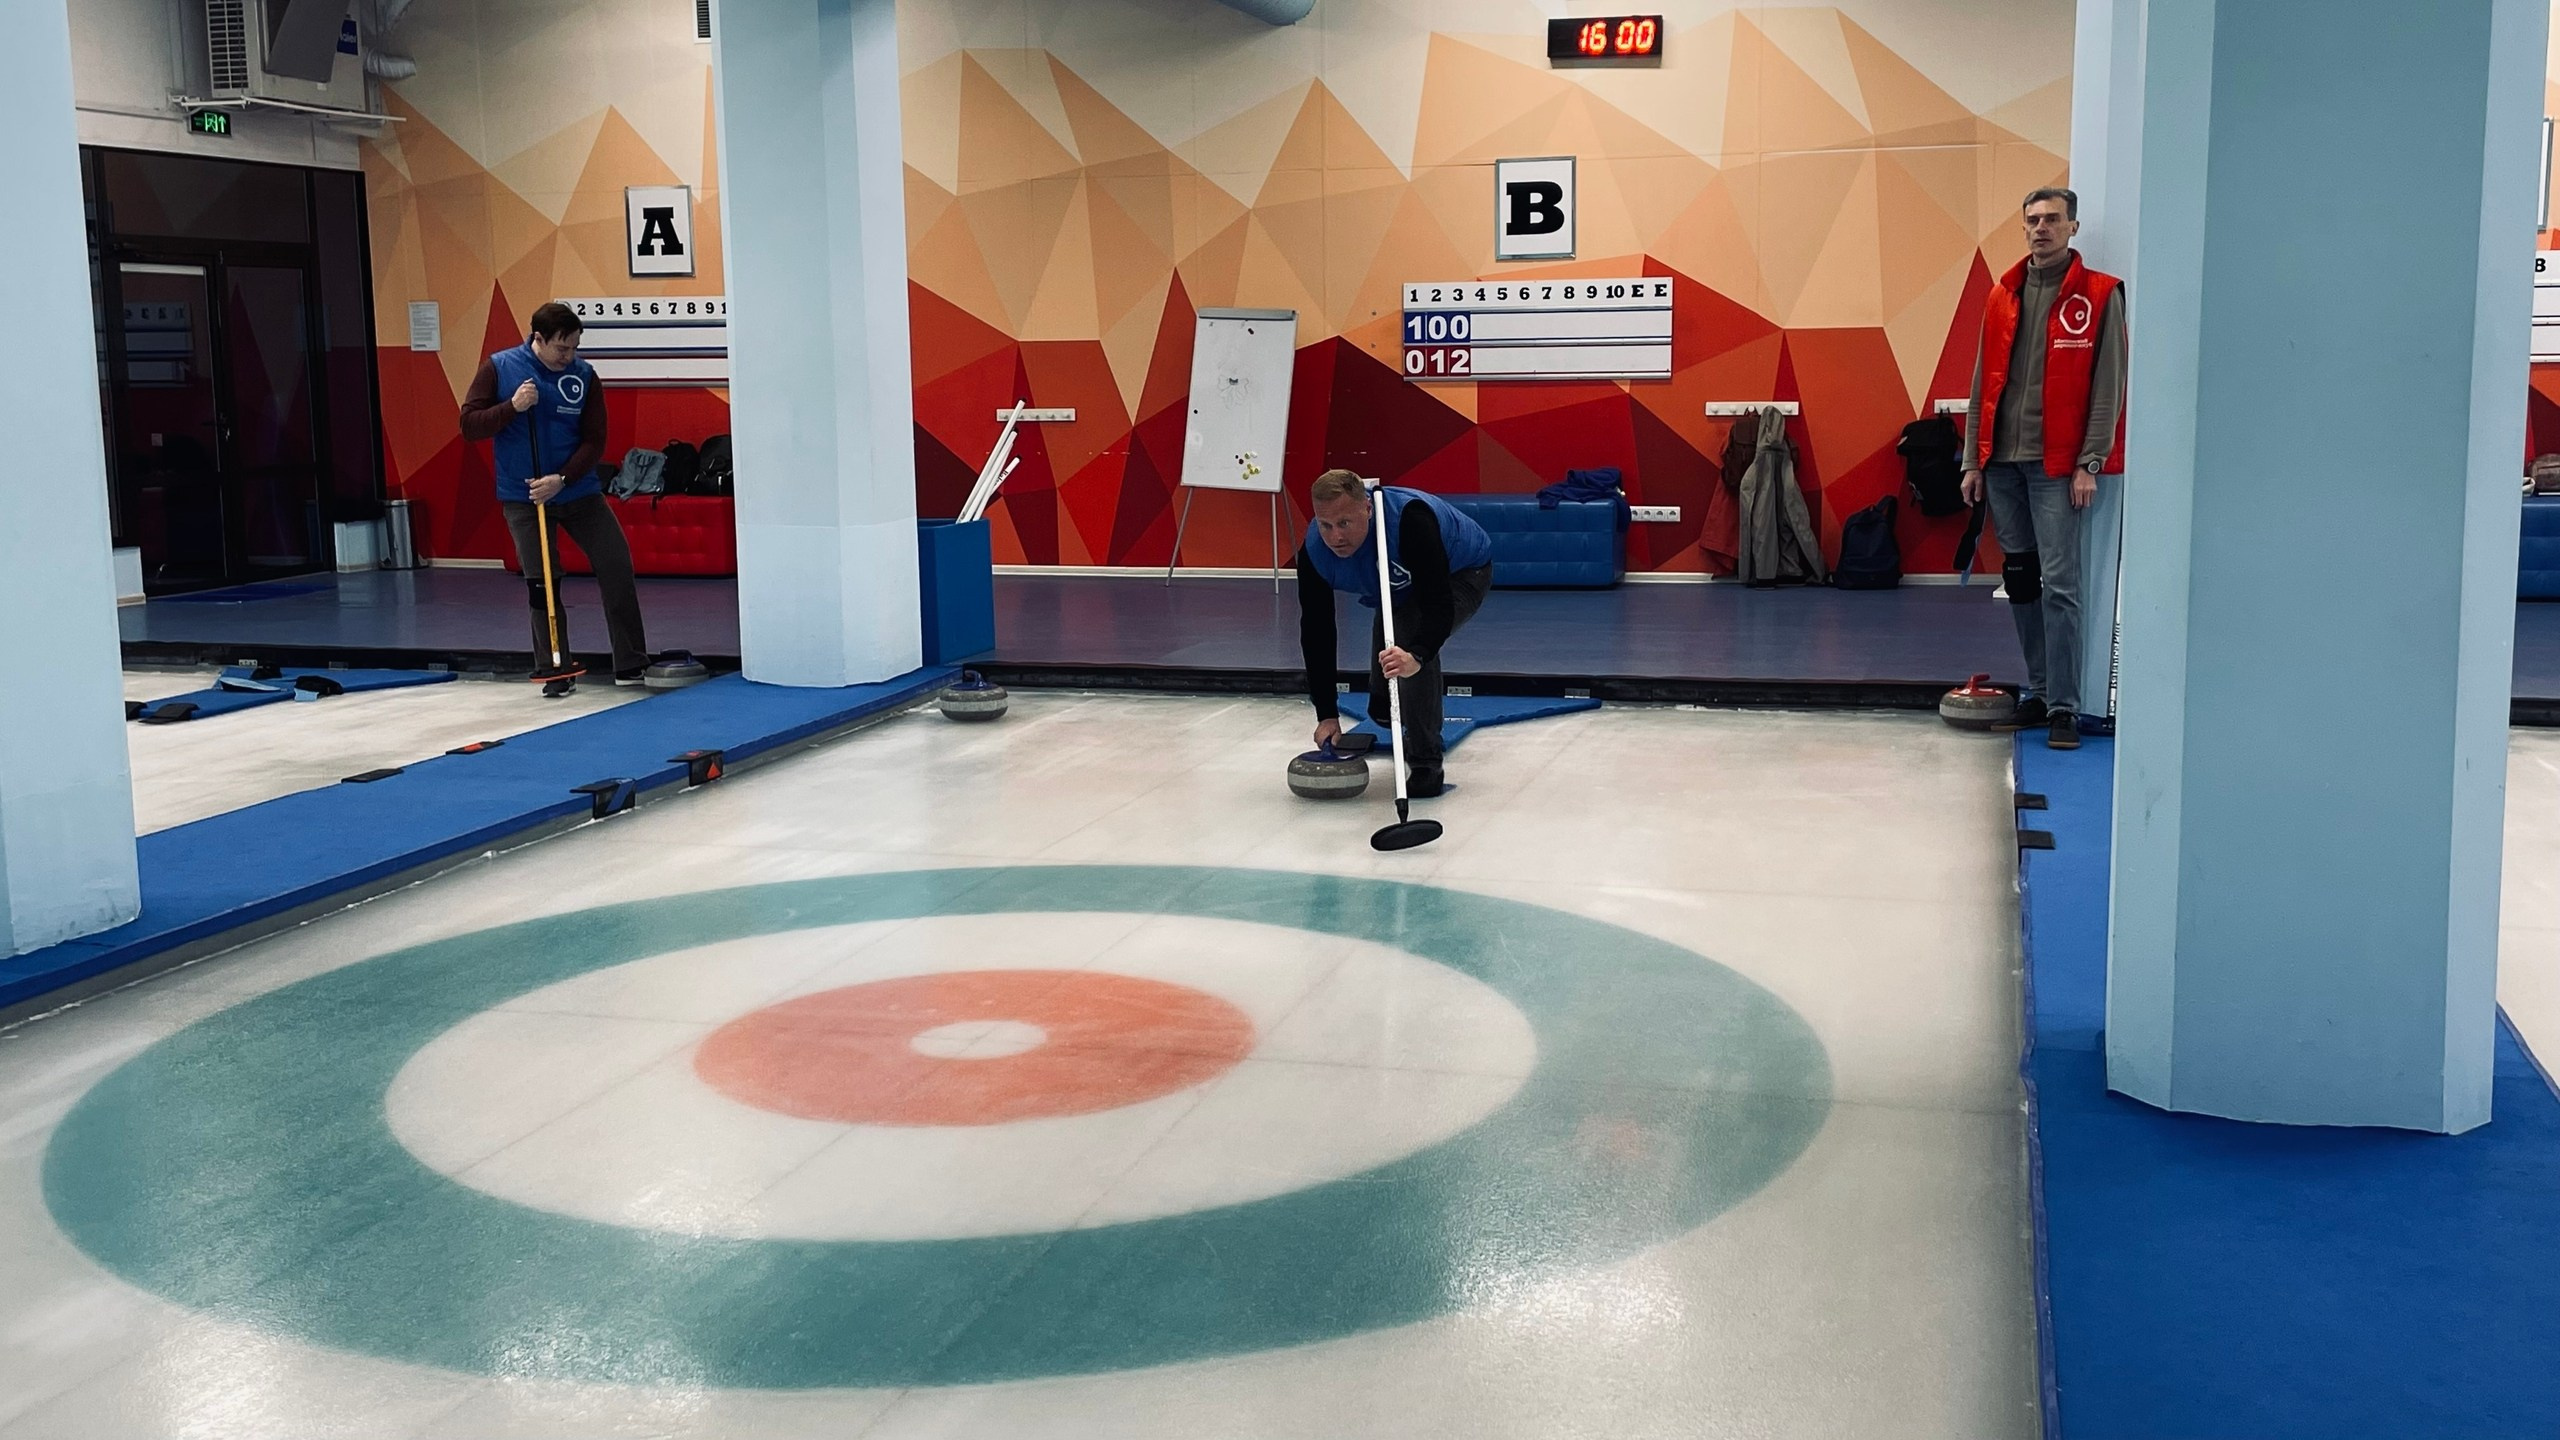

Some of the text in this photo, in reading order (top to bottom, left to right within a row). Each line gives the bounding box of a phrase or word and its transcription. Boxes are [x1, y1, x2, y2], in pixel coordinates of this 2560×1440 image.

[1580, 18, 1656, 54] 16 00
[1506, 181, 1565, 236] B
[637, 206, 684, 257] A
[577, 303, 587, 316] 2
[595, 303, 605, 316] 3
[613, 302, 623, 316] 4
[631, 302, 641, 315] 5
[649, 302, 660, 315] 6
[668, 302, 678, 315] 7
[686, 301, 697, 315] 8
[705, 301, 715, 315] 9
[1410, 283, 1668, 303] 1 2 3 4 5 6 7 8 9 10 E E
